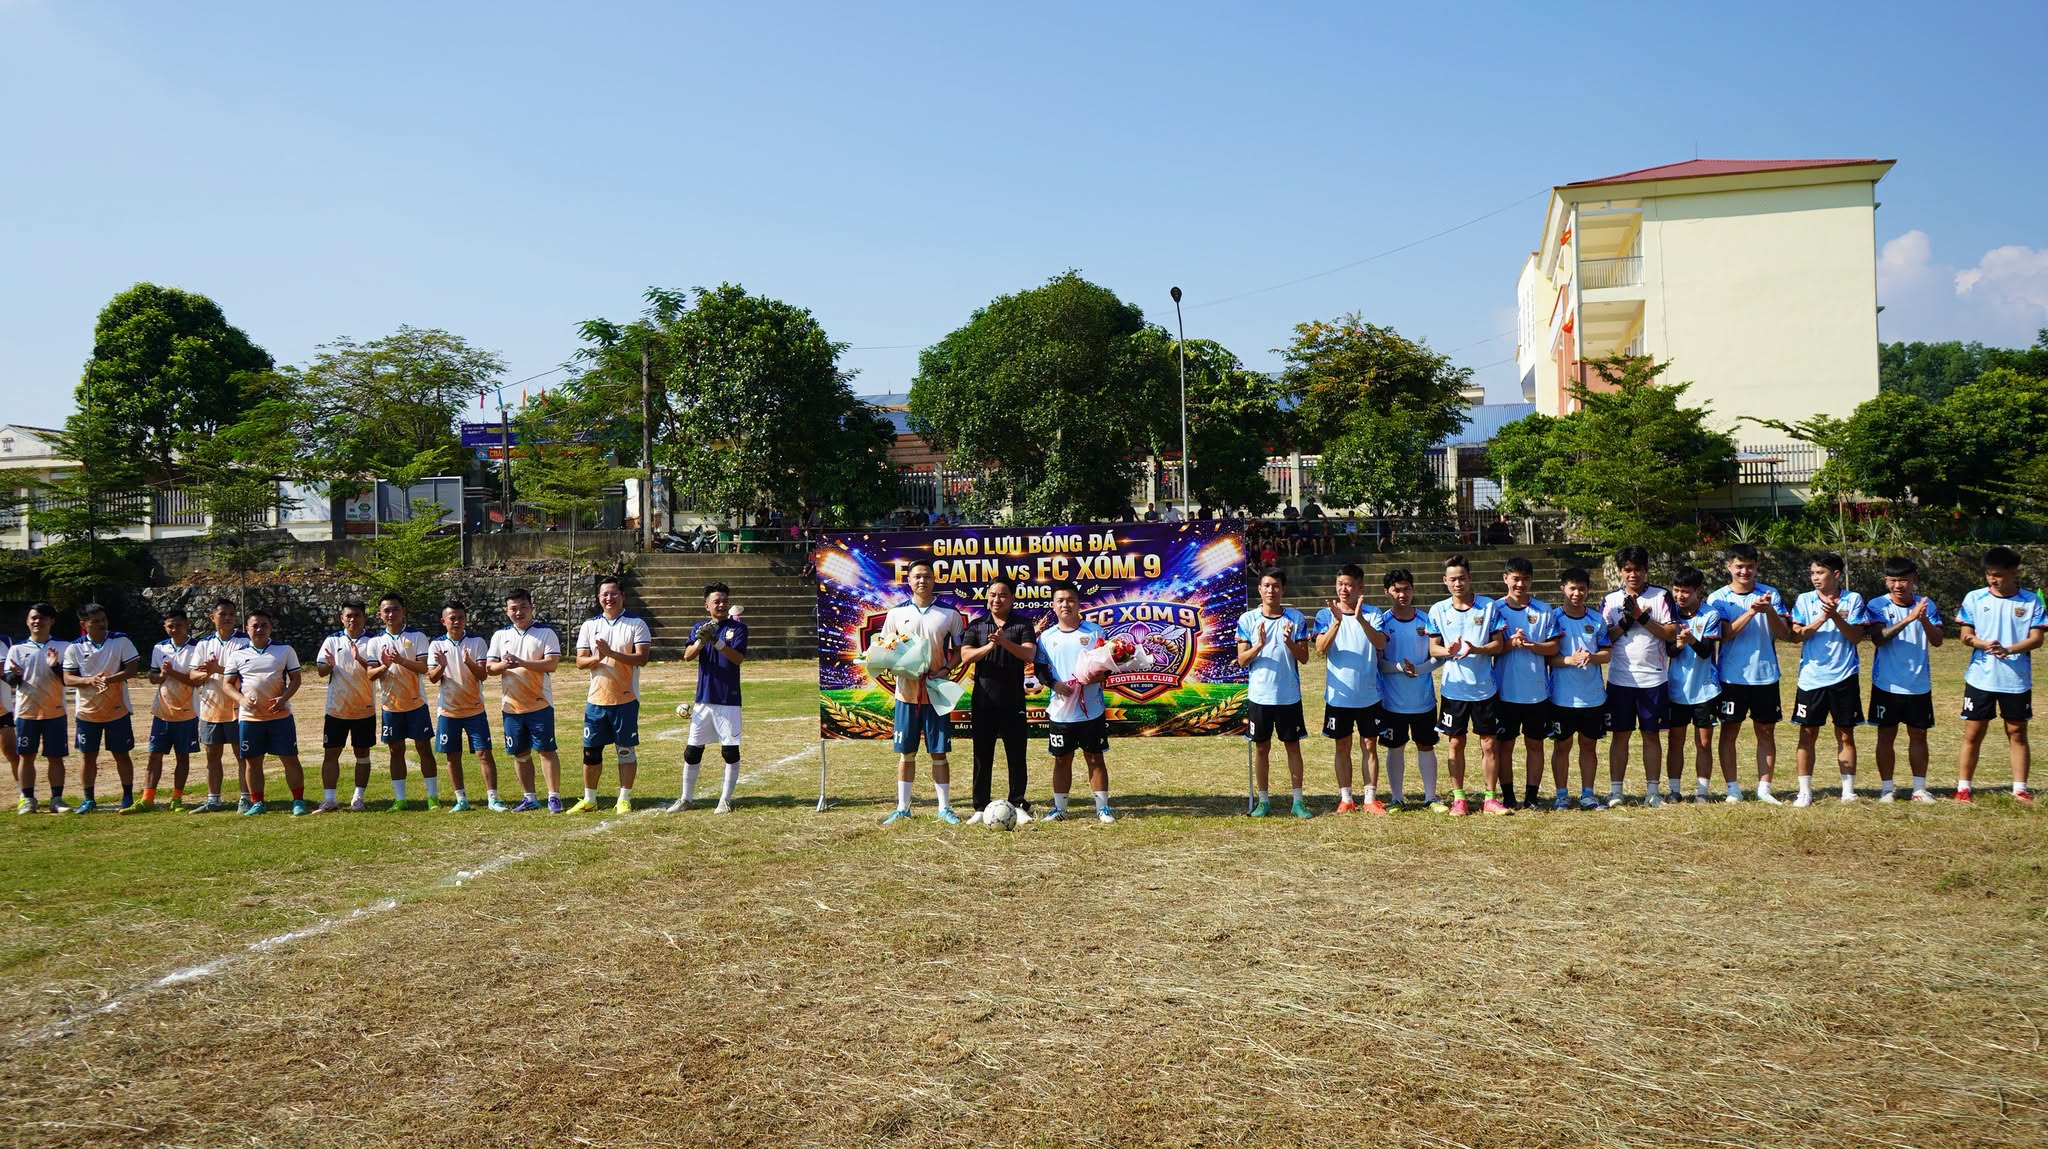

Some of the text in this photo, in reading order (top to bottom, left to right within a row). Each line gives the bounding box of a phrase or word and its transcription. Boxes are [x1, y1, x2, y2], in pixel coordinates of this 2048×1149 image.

[933, 529, 1117, 556] GIAO LƯU BÓNG ĐÁ
[894, 558, 909, 584] F
[933, 558, 999, 584] CATN
[1037, 557, 1069, 580] FC
[1076, 551, 1136, 580] XÓM
[1143, 553, 1161, 578] 9
[1014, 581, 1052, 599] ỒNG
[1013, 601, 1054, 610] 20-09-20
[1085, 602, 1196, 628] FC XÓM 9
[1110, 674, 1174, 684] FOOTBALL CLUB
[1721, 700, 1735, 715] 20
[1796, 703, 1807, 718] 15
[1963, 696, 1974, 711] 14
[1876, 705, 1887, 719] 17
[1441, 712, 1453, 728] 30
[382, 725, 393, 737] 21
[894, 730, 903, 744] 11
[17, 736, 29, 748] 13
[240, 740, 250, 752] 5
